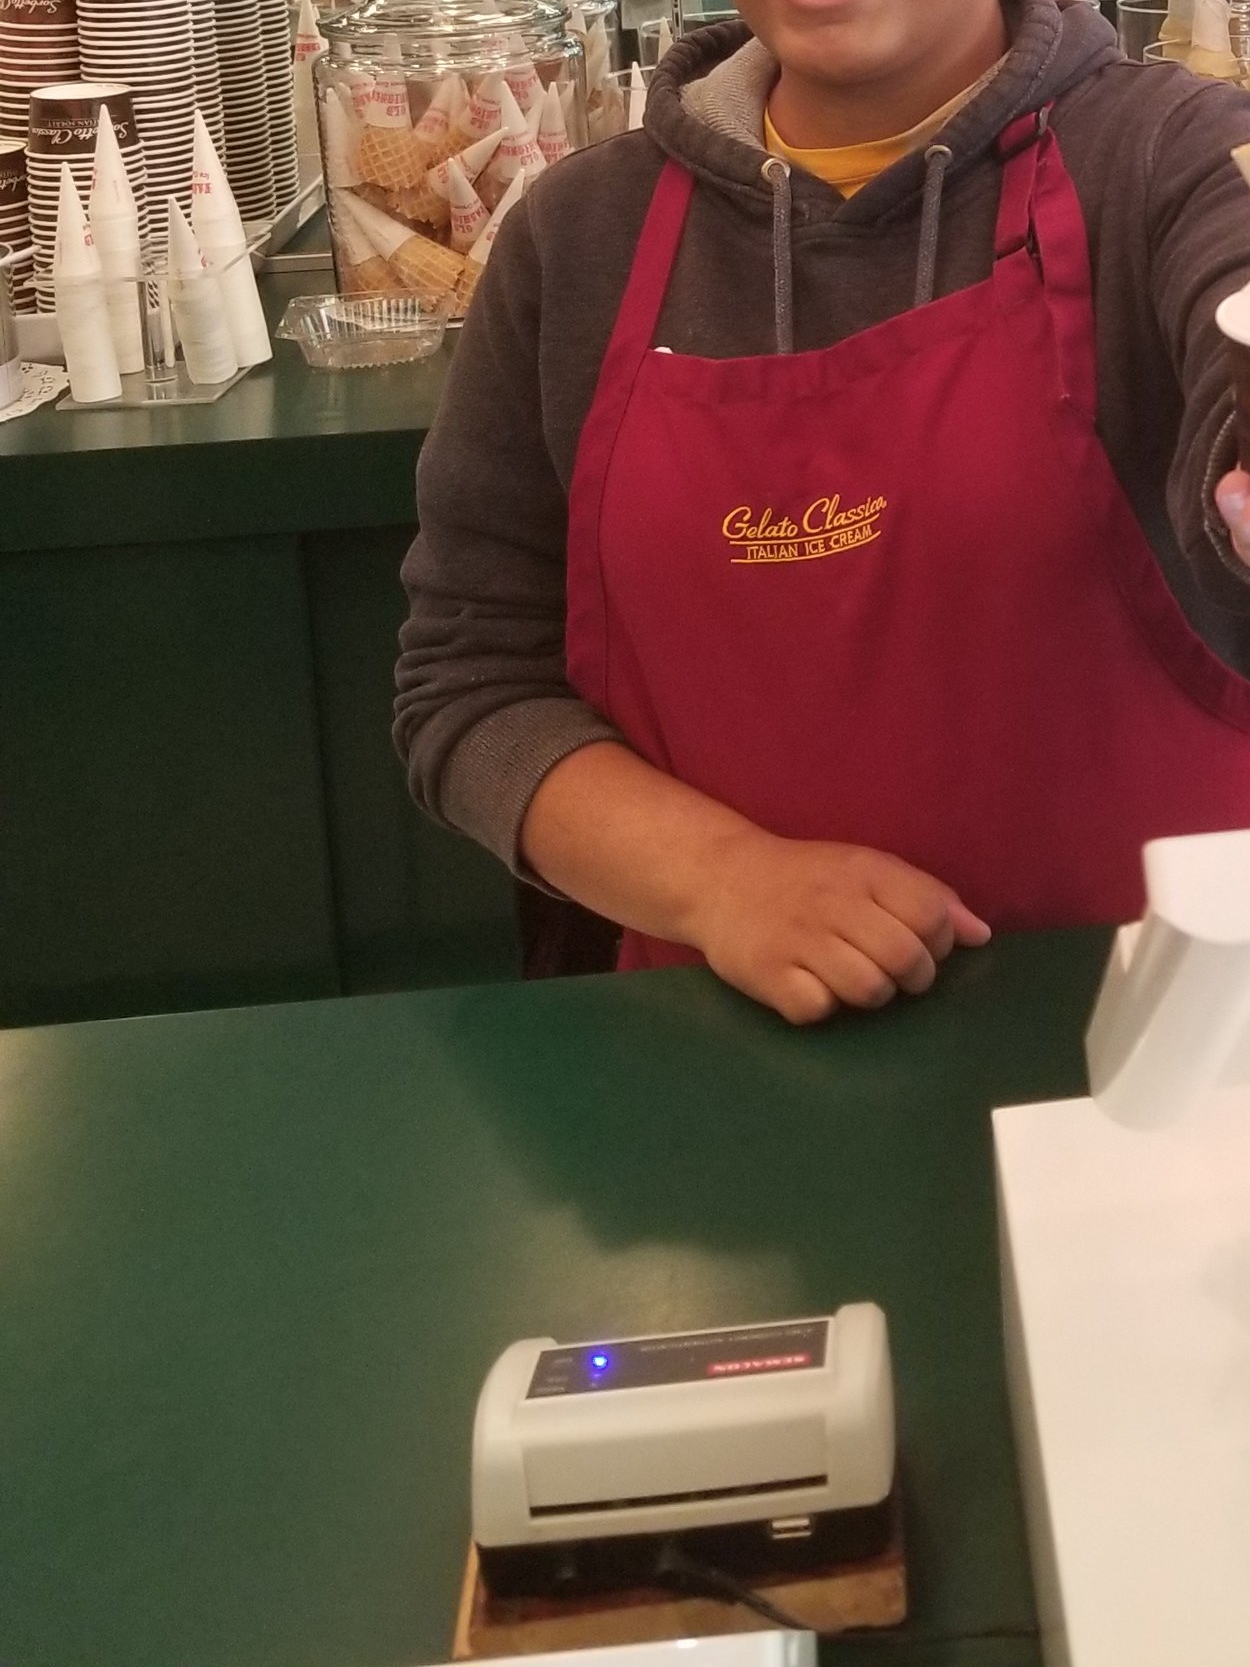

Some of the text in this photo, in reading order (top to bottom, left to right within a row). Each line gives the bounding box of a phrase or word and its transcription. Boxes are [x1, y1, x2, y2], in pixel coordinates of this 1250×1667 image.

[722, 494, 884, 539] Gelato Classico
[747, 525, 872, 559] ITALIAN ICE CREAM
